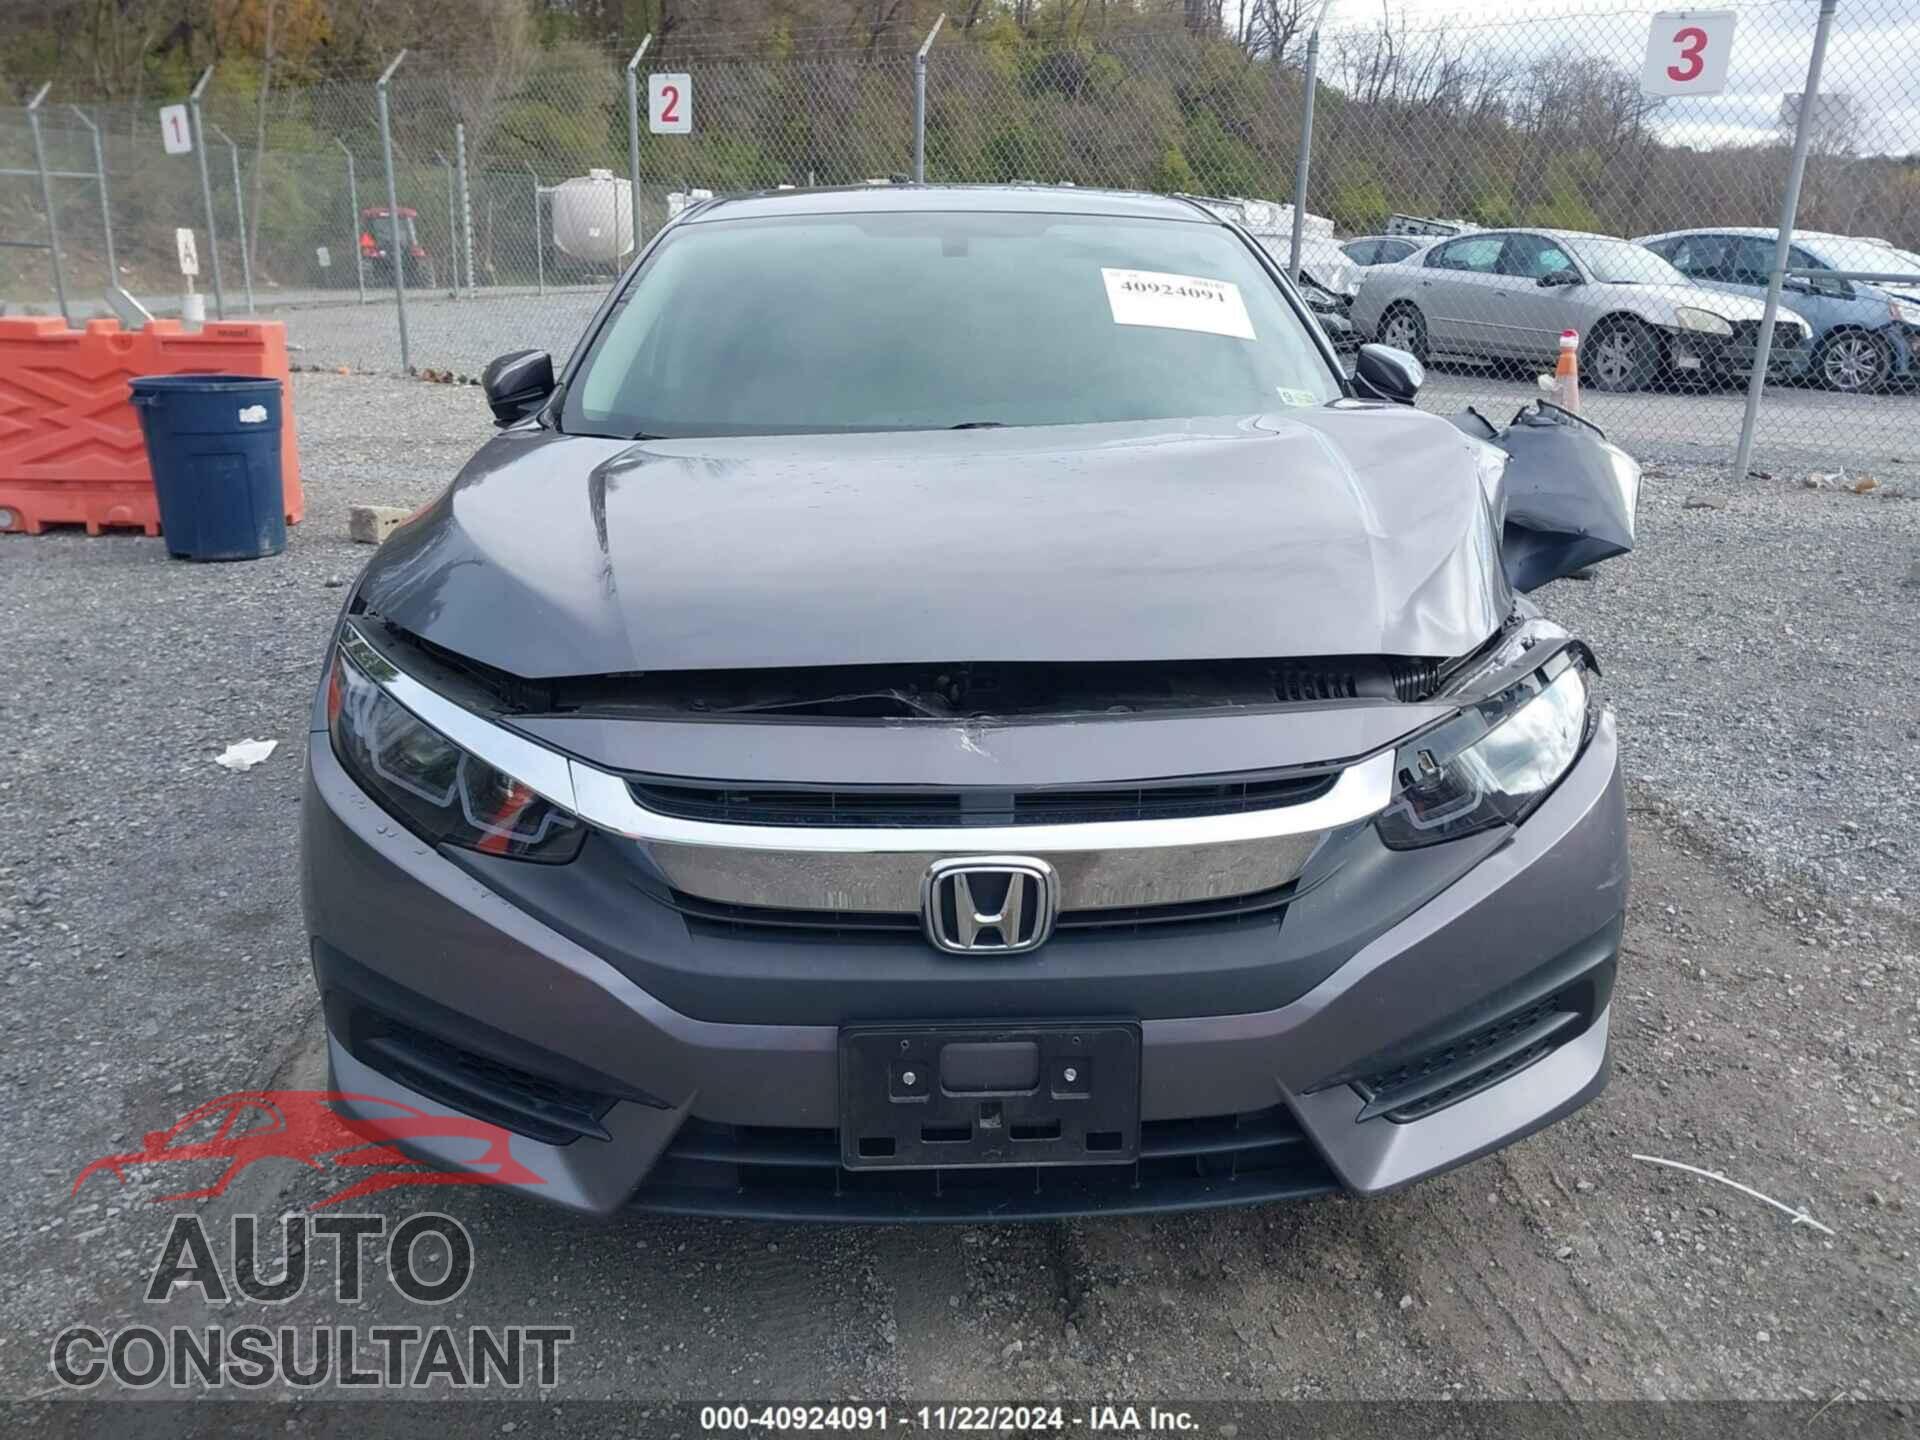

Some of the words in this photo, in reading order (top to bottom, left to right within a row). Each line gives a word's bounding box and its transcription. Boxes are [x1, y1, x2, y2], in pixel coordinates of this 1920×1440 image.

[1667, 27, 1708, 81] 3
[662, 86, 679, 122] 2
[170, 115, 181, 144] 1
[1121, 281, 1224, 302] 40924091
